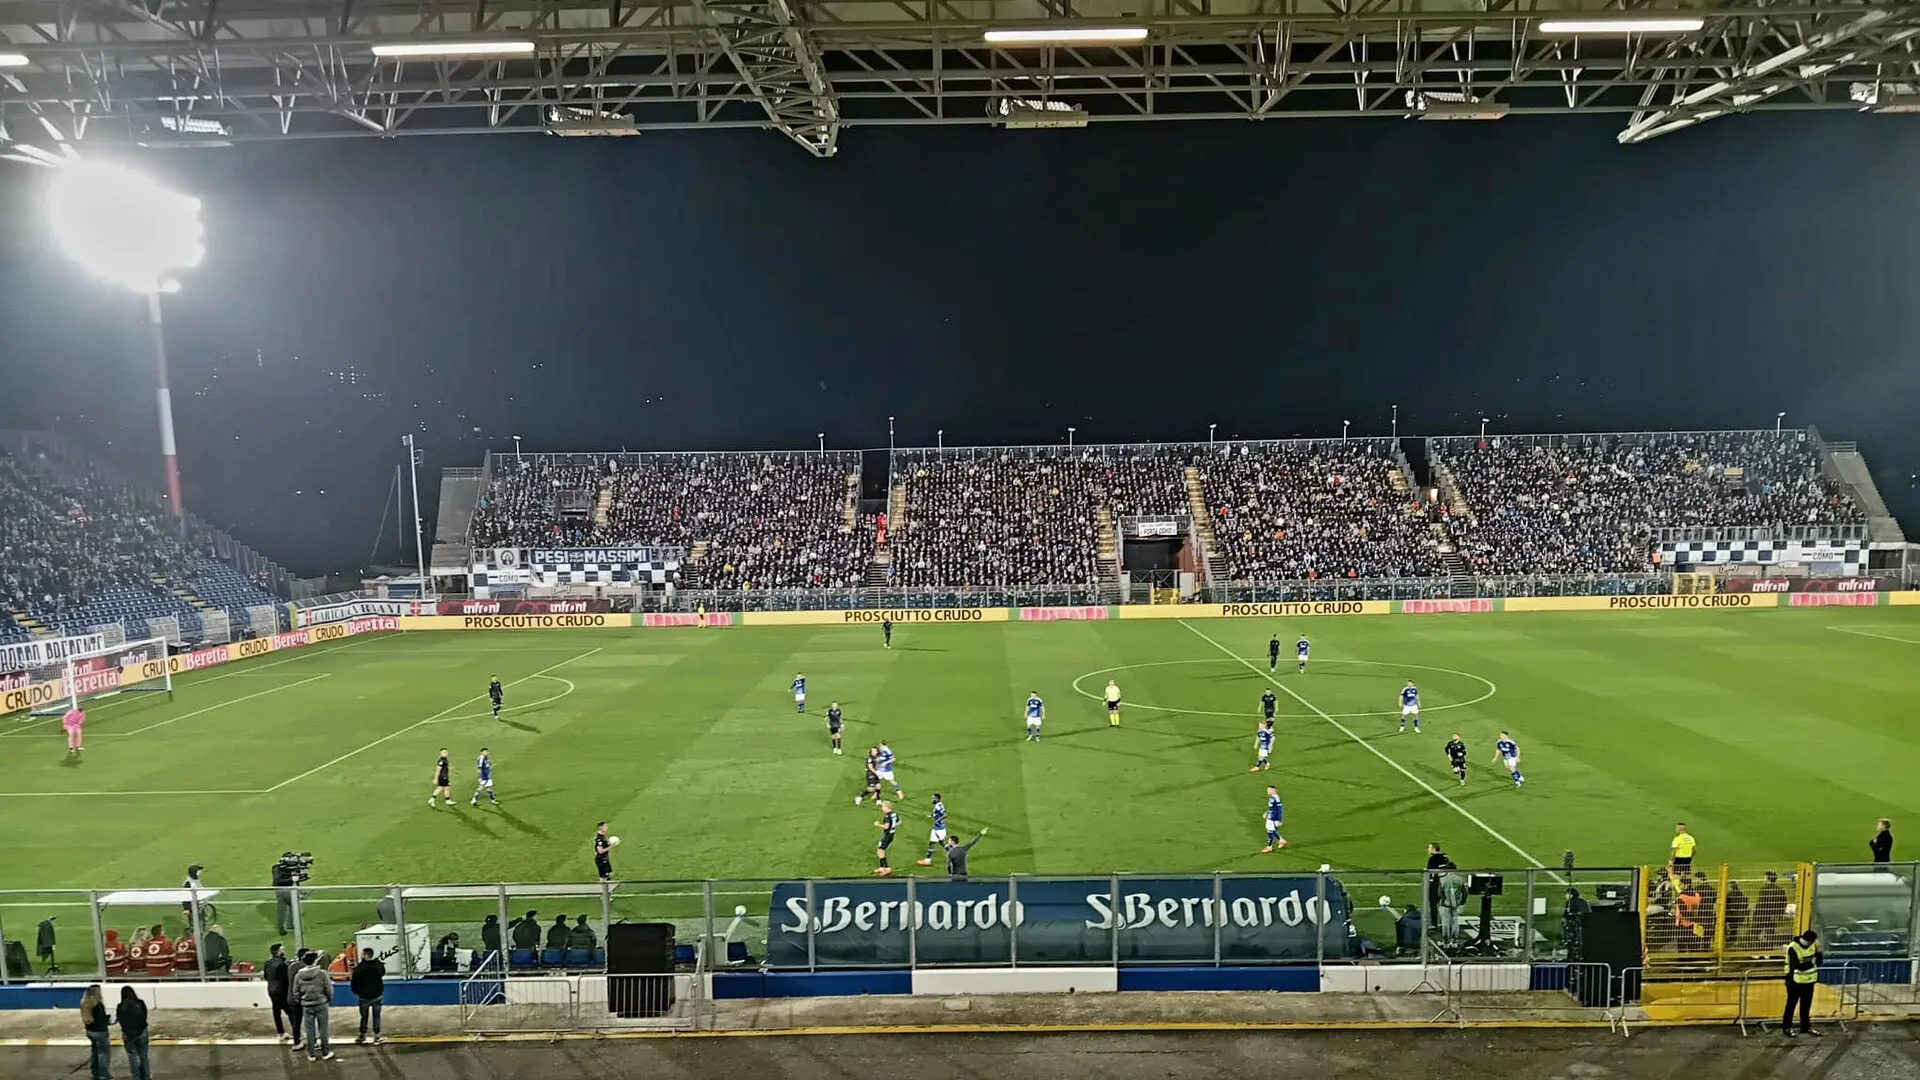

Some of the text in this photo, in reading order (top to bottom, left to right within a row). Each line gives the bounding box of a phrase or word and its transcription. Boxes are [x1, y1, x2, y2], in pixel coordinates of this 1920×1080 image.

[535, 550, 647, 563] PESI MASSIMI
[1812, 551, 1834, 560] COMO
[498, 574, 519, 583] COMO
[1222, 602, 1363, 616] PROSCIUTTO CRUDO
[1610, 594, 1751, 609] PROSCIUTTO CRUDO
[465, 615, 605, 628] PROSCIUTTO CRUDO
[845, 609, 982, 623] PROSCIUTTO CRUDO
[316, 625, 344, 641] CRUDO
[349, 616, 395, 635] Beretta
[240, 638, 268, 657] CRUDO
[274, 630, 309, 650] Beretta
[185, 646, 228, 670] Beretta
[6, 684, 53, 710] CRUDO
